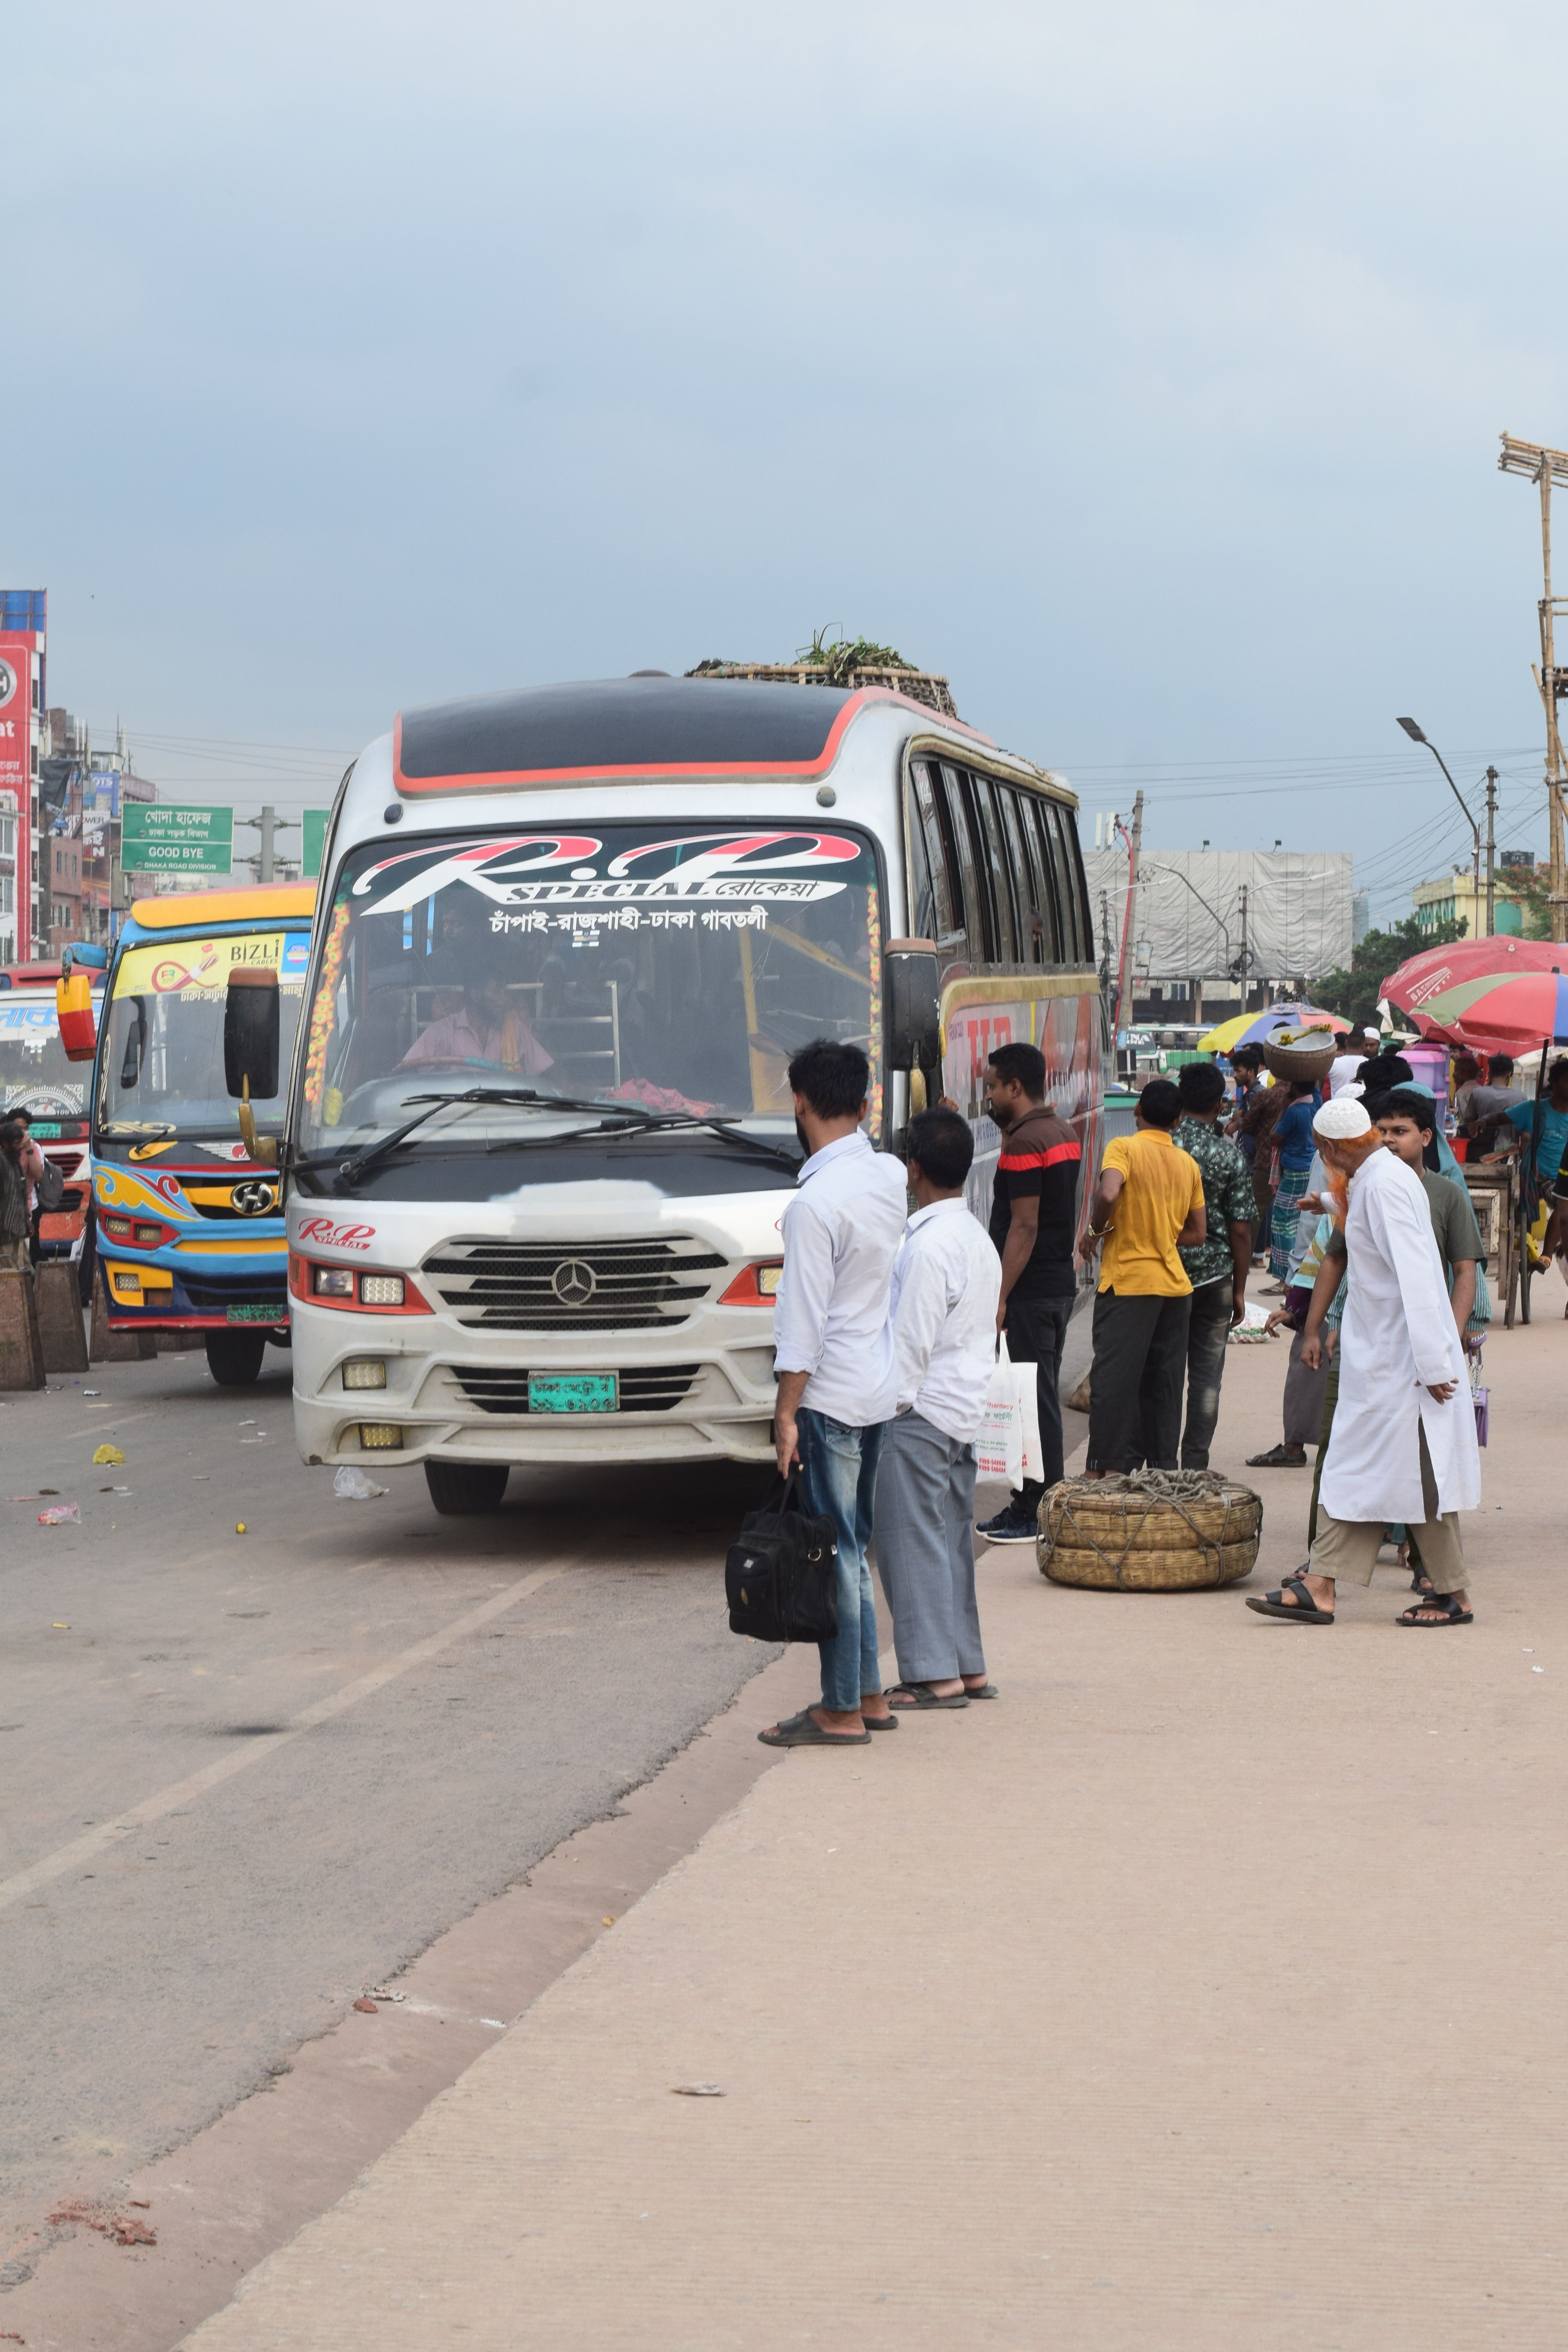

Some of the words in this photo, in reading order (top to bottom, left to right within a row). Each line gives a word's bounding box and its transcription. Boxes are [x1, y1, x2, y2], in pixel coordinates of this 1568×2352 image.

[145, 810, 173, 824] খোদা
[175, 810, 212, 826] হাফেজ
[149, 829, 165, 837] ঢাকা
[187, 828, 209, 838] বিভাগ
[149, 846, 180, 858] GOOD
[182, 848, 203, 858] BYE
[506, 882, 710, 901] SPECIAL
[715, 879, 820, 898] রোকেয়া
[489, 906, 696, 934] চাঁপাই-রাজশাহী-ঢাকা
[701, 904, 768, 931] গাবতলী
[317, 1236, 365, 1250] SPECIAL
